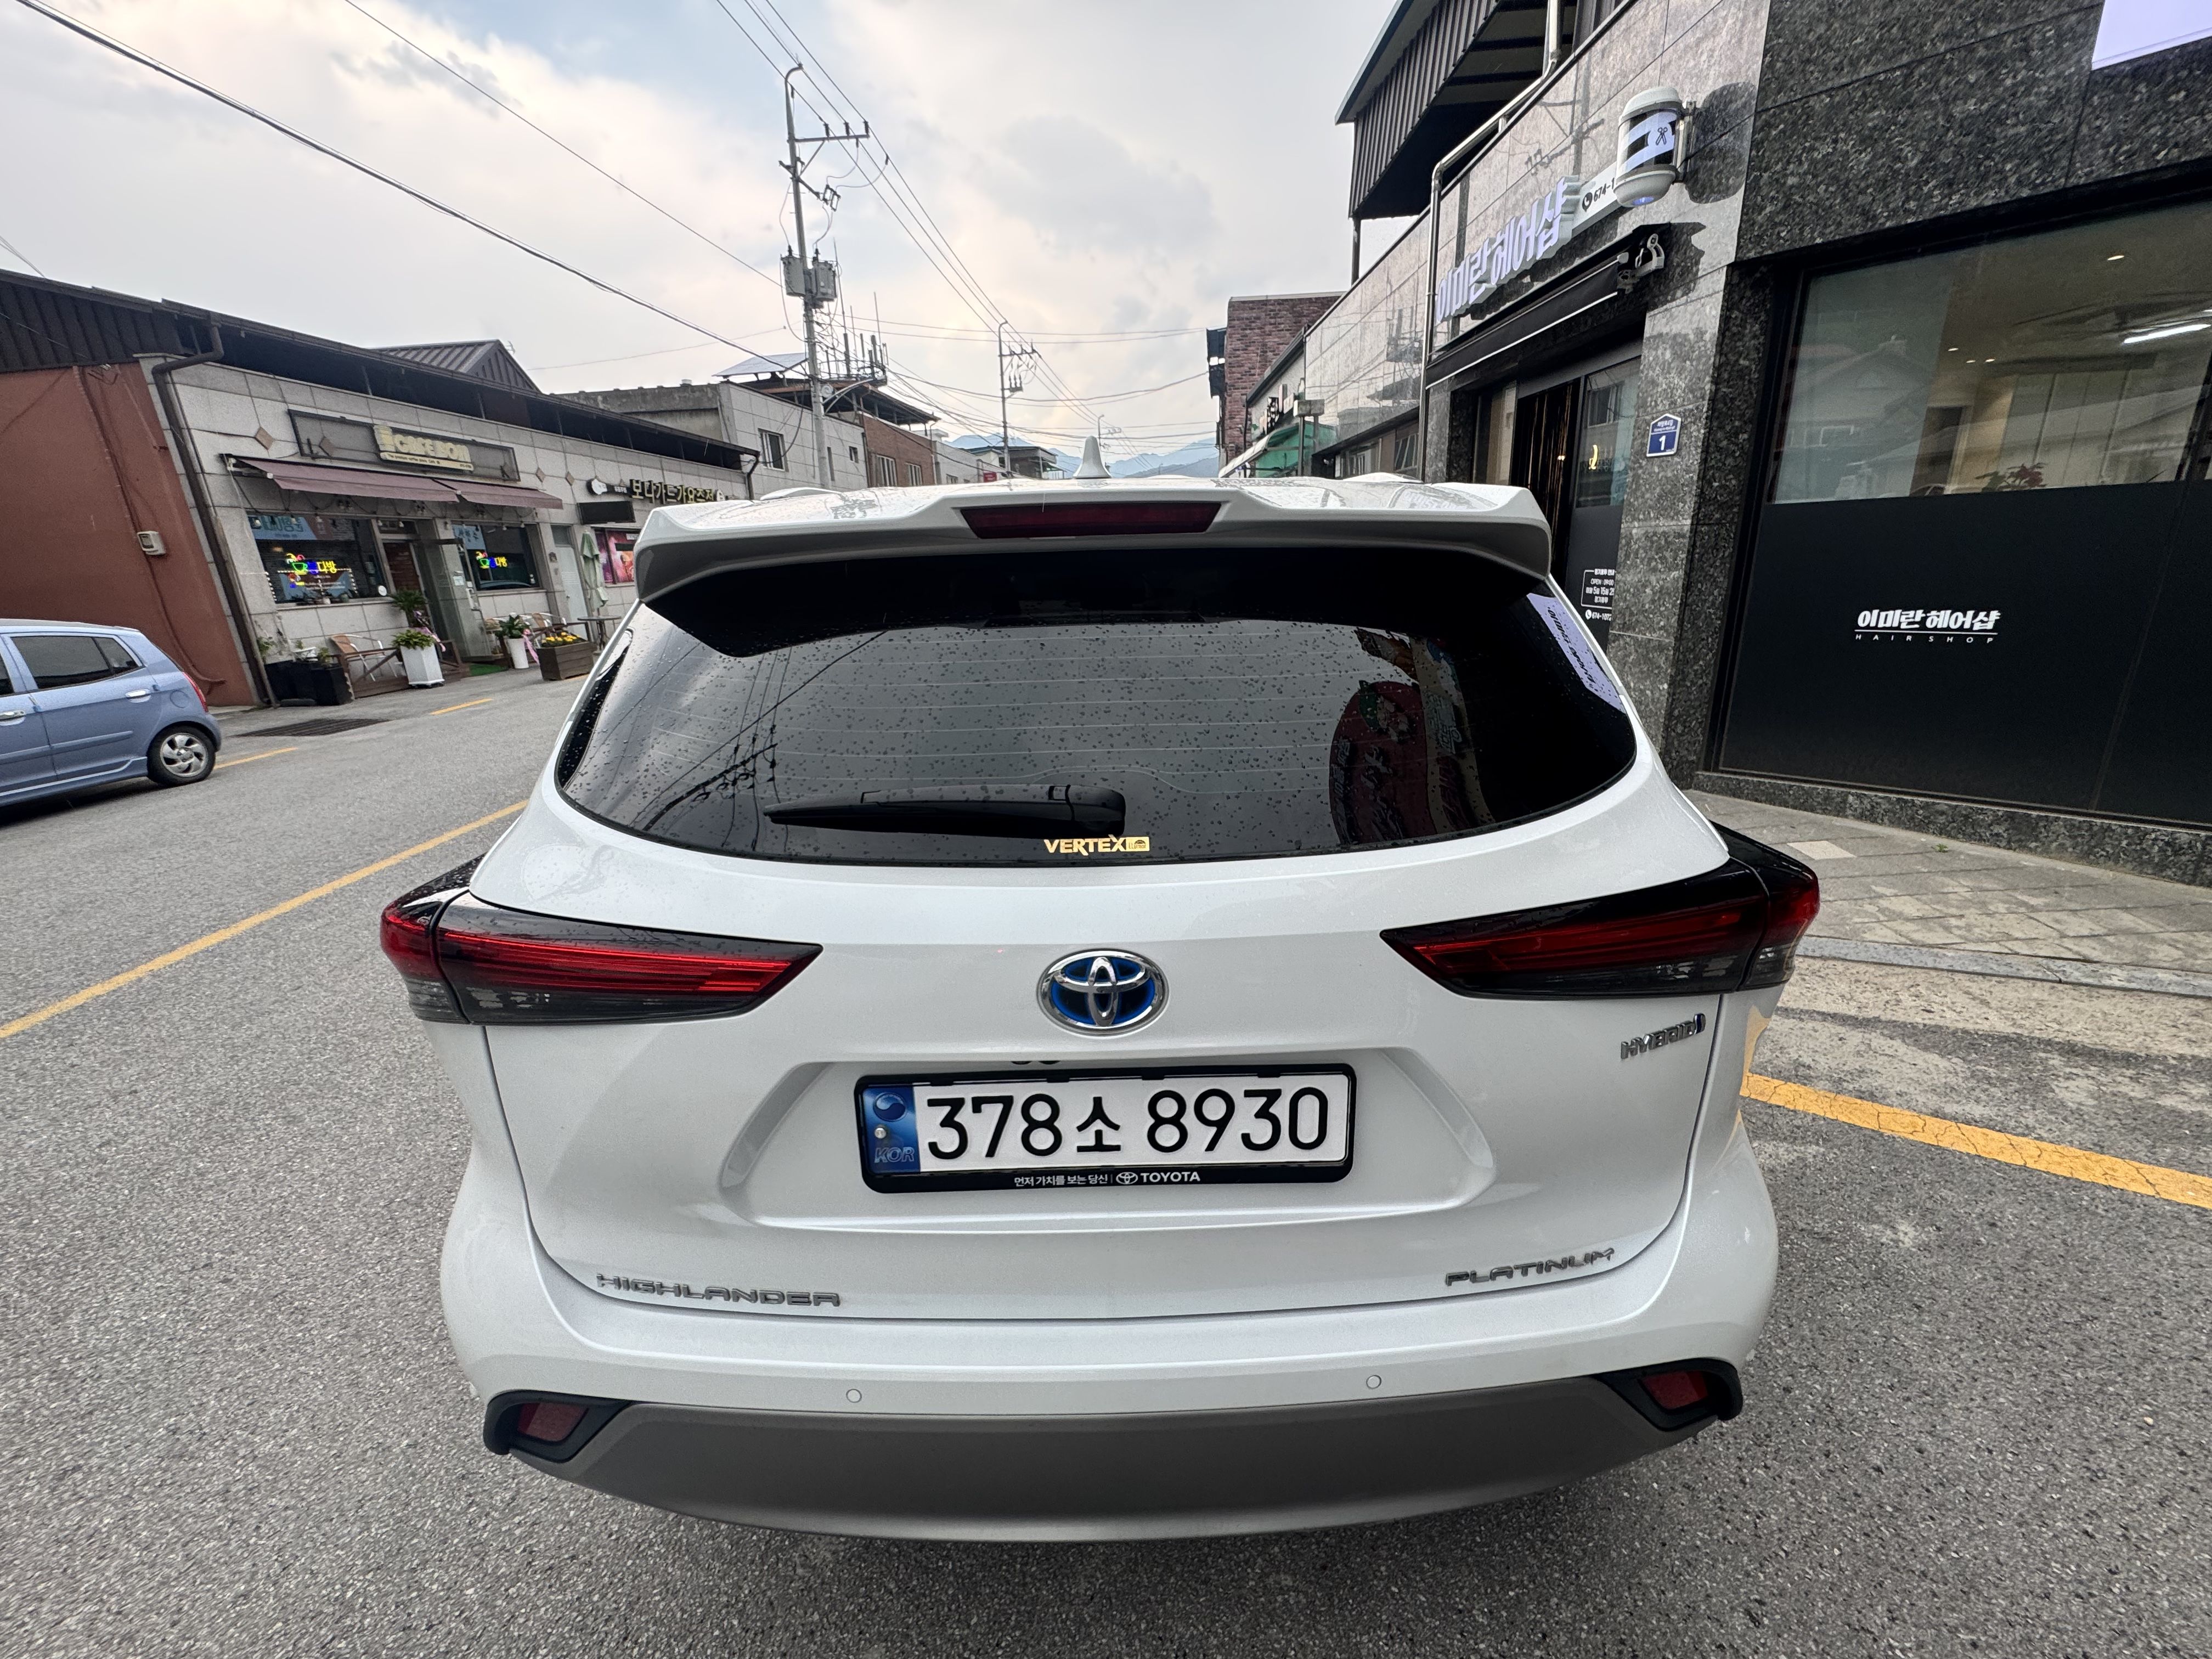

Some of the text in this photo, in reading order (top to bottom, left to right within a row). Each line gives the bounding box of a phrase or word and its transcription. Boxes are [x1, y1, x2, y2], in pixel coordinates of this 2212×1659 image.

[1659, 435, 1666, 451] 1
[1043, 834, 1125, 856] VERTEX
[1621, 1020, 1696, 1059] HYBRID
[1147, 1086, 1328, 1153] 8930
[874, 1146, 915, 1163] KOR
[1014, 1172, 1200, 1186] 먼저 가치를 보는 당신 TOYOTA
[1445, 1247, 1615, 1286] PLATINUM
[596, 1273, 840, 1307] HIGHLANDER
